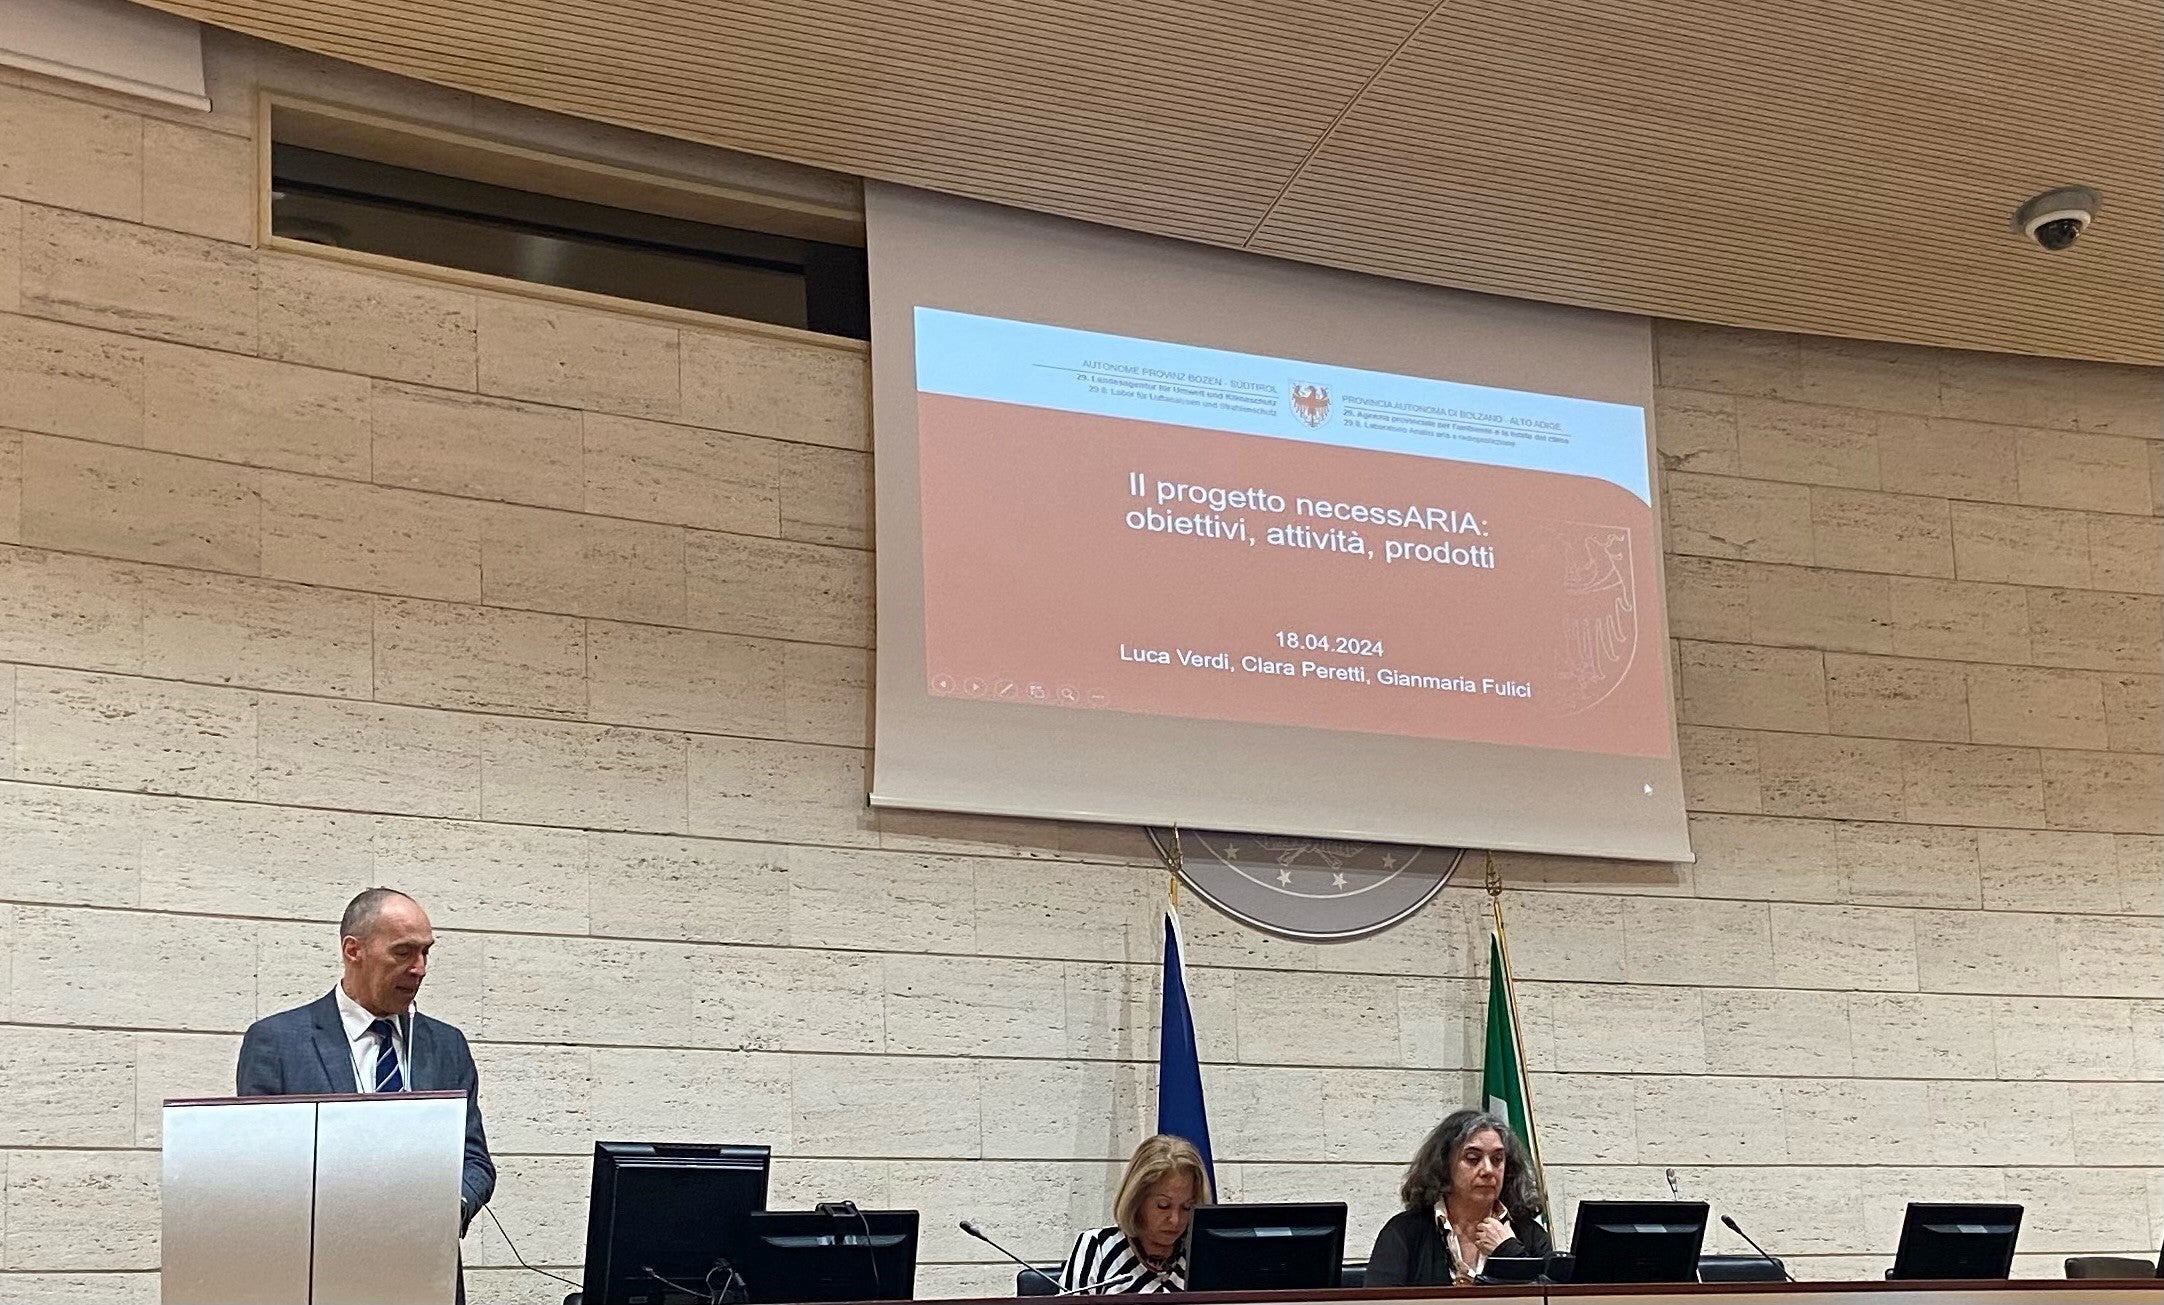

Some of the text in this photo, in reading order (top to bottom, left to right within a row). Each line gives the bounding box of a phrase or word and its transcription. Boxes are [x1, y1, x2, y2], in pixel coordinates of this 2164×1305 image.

[1128, 471, 1490, 537] Il progetto necessARIA:
[1125, 509, 1496, 569] obiettivi, attività, prodotti
[1119, 643, 1532, 699] Luca Verdi, Clara Peretti, Gianmaria Fulici
[1275, 631, 1385, 657] 18.04.2024
